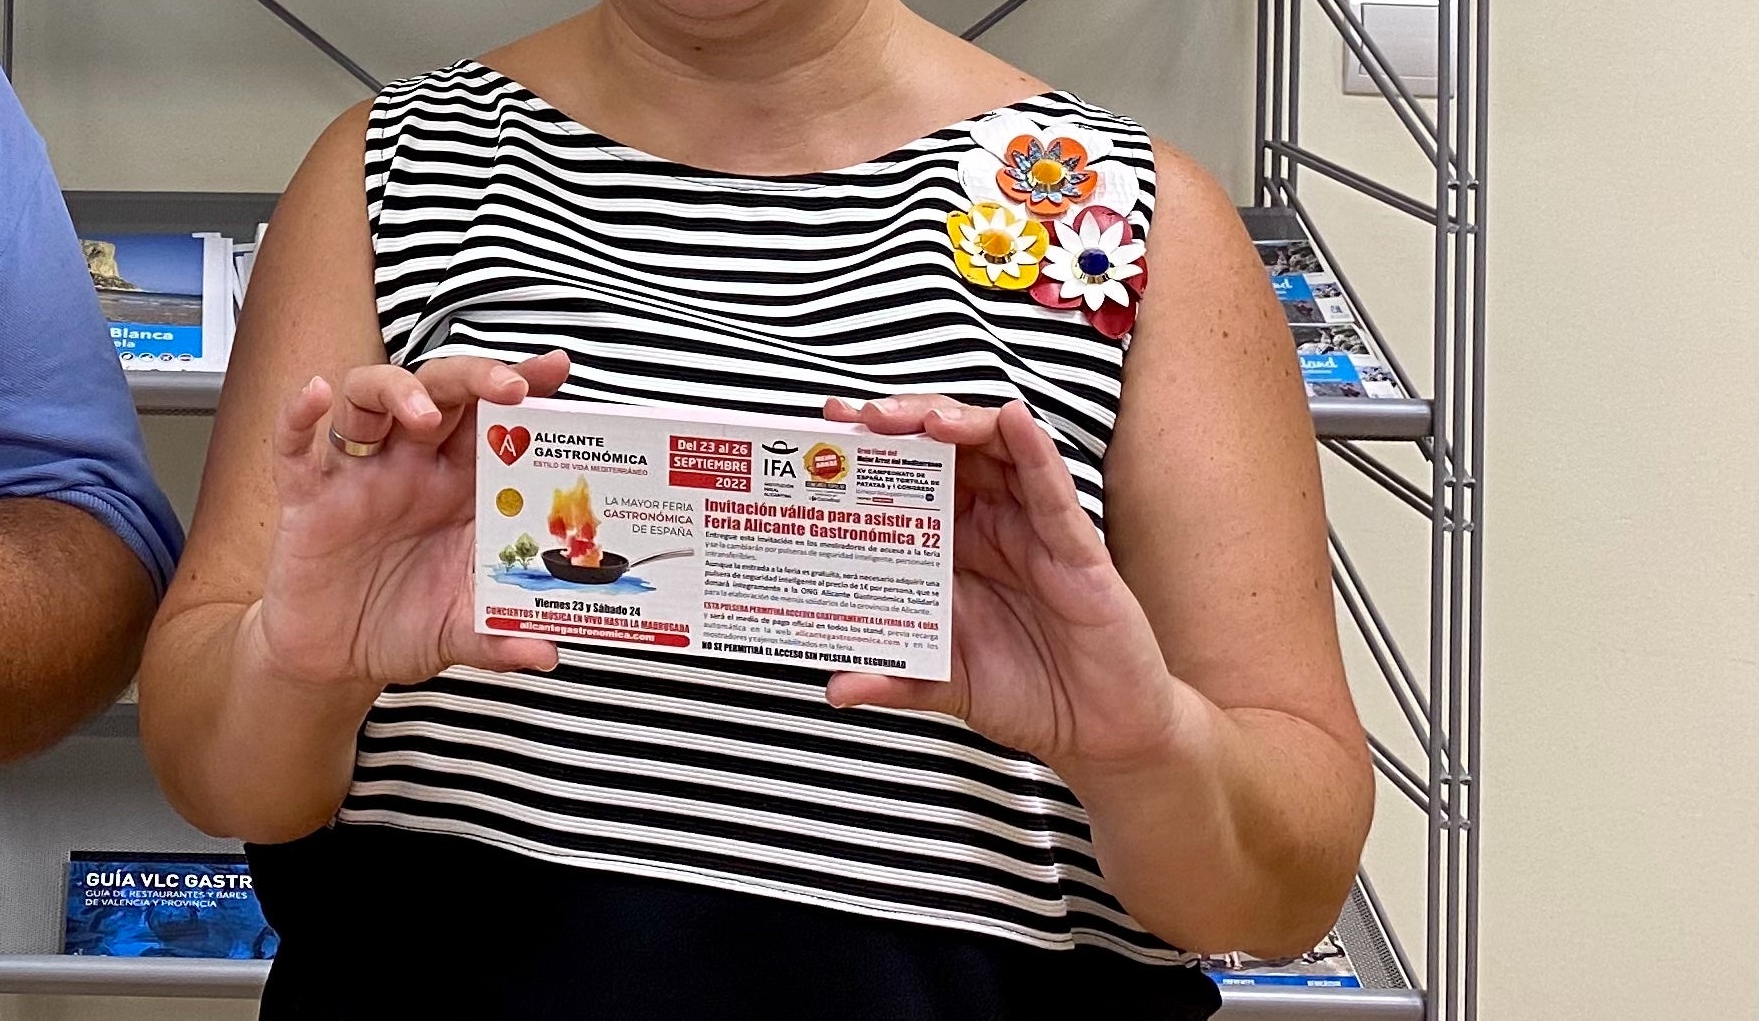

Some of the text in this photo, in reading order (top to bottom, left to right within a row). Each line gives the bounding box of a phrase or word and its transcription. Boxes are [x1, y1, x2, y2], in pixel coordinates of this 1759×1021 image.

[110, 328, 173, 340] Blanca
[534, 431, 604, 447] ALICANTE
[677, 439, 747, 455] Del 23 al 26
[534, 444, 647, 465] GASTRONÓMICA
[533, 459, 647, 476] ESTILO DE VIDA MEDITERRÁNEO
[673, 456, 747, 472] SEPTIEMBRE
[764, 458, 796, 478] IFA
[715, 476, 746, 489] 2022
[605, 496, 693, 512] LA MAYOR FERIA
[603, 506, 693, 525] GASTRONÓMICA
[705, 497, 940, 531] Invitación válida para asistir a la
[632, 523, 692, 537] DE ESPAÑA
[704, 513, 940, 549] Feria Alicante Gastronómica 22
[535, 597, 640, 617] Viernes 23 y Sábado 24
[486, 605, 689, 633] CONCIERTOS Y MÚSICA EN VIVO HASTA LA MADRUGADA
[519, 621, 654, 643] alicantegastronomica.com
[702, 641, 905, 668] NO SE PERMITIRÁ EL ACCESO SIN PULSERA DE SEGURIDAD
[86, 869, 252, 889] GUÍA VLC GASTR
[85, 889, 110, 897] GUÍA
[129, 890, 204, 898] RESTAURANTES
[101, 899, 150, 907] VALENCIA
[161, 900, 217, 908] PROVINCIA
